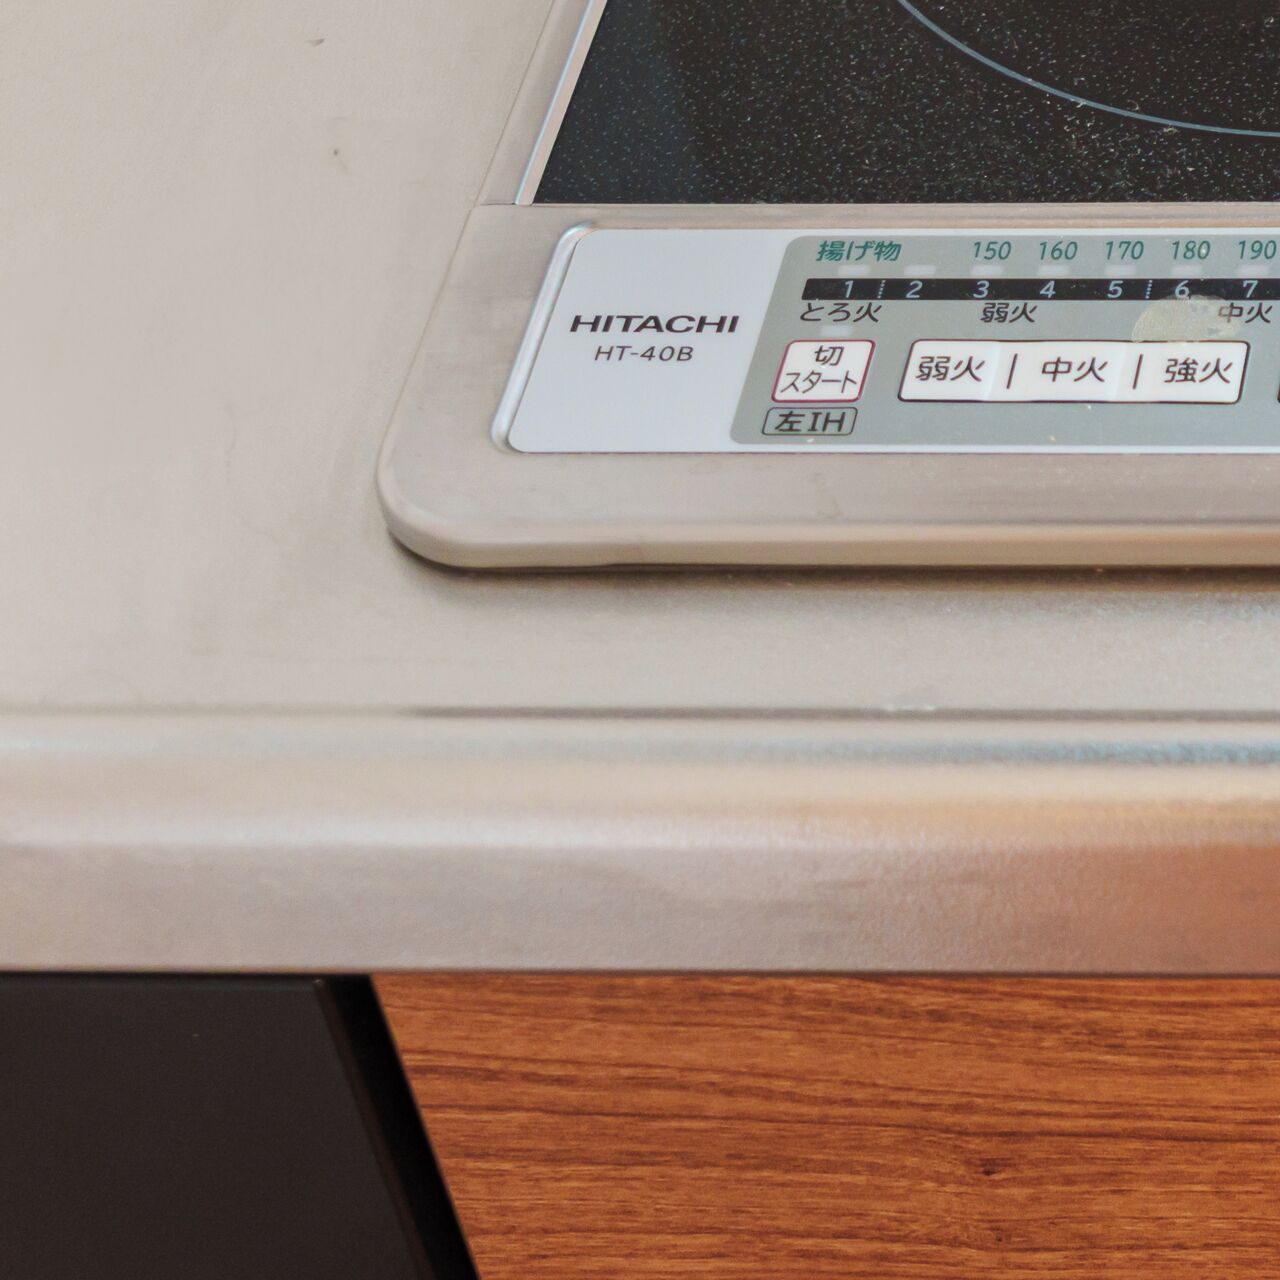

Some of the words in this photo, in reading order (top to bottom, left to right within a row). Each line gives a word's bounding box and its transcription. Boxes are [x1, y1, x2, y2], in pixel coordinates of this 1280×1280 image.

[815, 240, 902, 262] 揚げ物
[973, 240, 1012, 261] 150
[1039, 240, 1079, 261] 160
[1105, 240, 1145, 261] 170
[1171, 240, 1211, 261] 180
[1238, 239, 1277, 260] 190
[843, 280, 854, 298] 1
[905, 280, 923, 298] 2
[972, 280, 990, 298] 3
[1039, 280, 1057, 298] 4
[1106, 280, 1124, 298] 5
[1174, 280, 1190, 298] 6
[1242, 280, 1259, 298] 7
[569, 314, 740, 334] HITACHI
[799, 301, 883, 323] とろ火
[980, 301, 1038, 324] 弱火
[1217, 302, 1274, 324] 中火
[594, 345, 694, 362] HT-40B
[814, 345, 845, 367] 切
[915, 355, 985, 382] 弱火
[1041, 356, 1108, 383] 中火
[1164, 357, 1233, 384] 強火
[780, 370, 858, 394] スタート
[774, 410, 846, 433] 左IH
